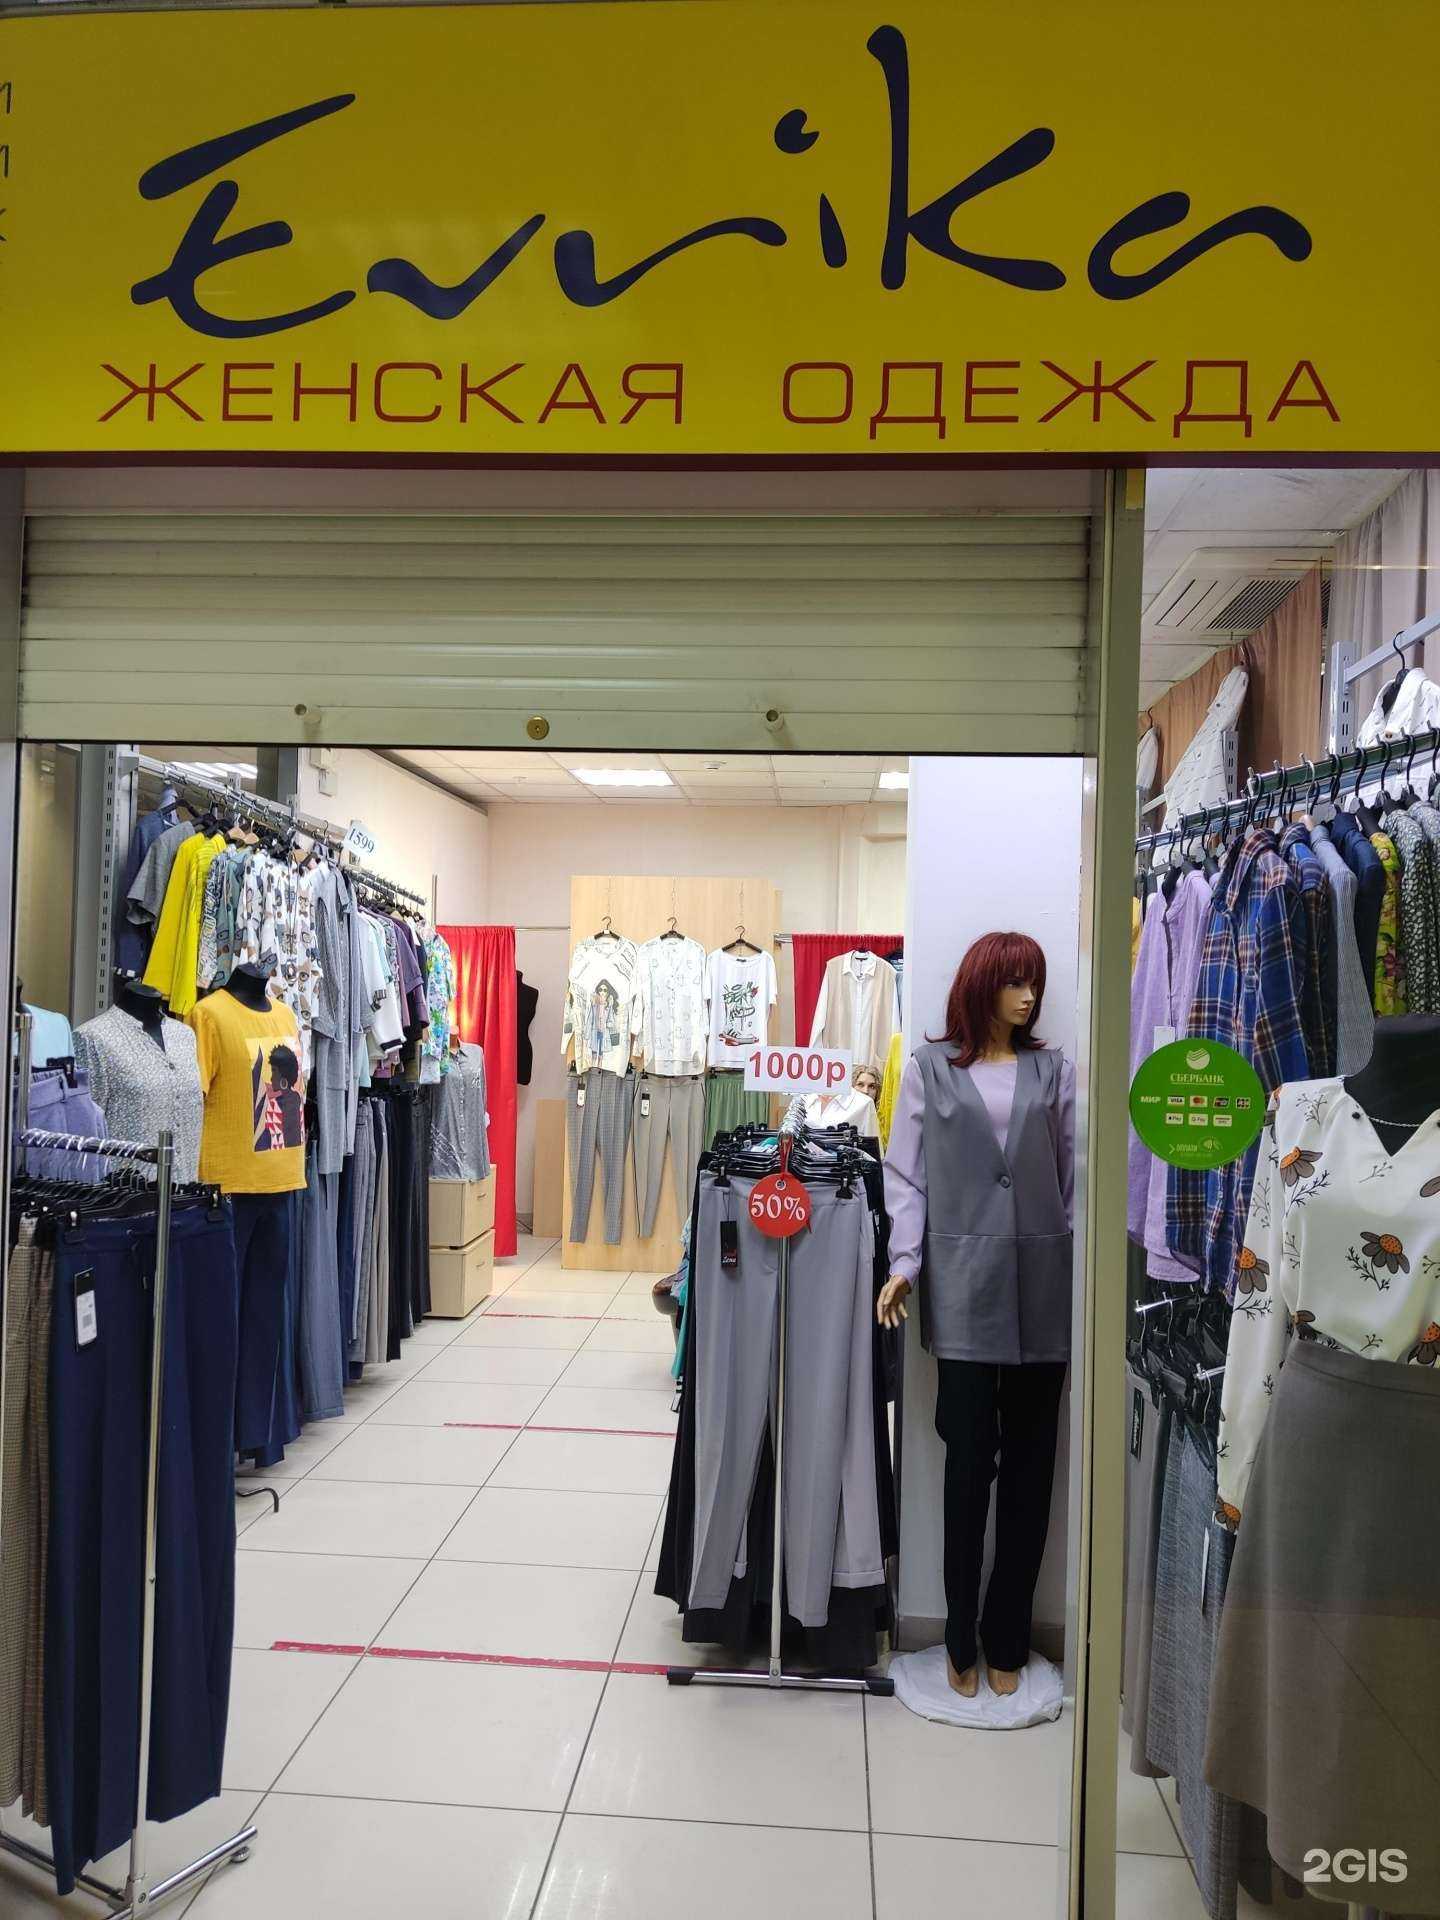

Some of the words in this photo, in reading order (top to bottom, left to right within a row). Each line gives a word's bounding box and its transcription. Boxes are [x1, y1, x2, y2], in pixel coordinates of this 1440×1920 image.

[98, 363, 684, 424] ЖЕНСКАЯ
[782, 360, 1341, 440] ОДЕЖДА
[349, 828, 375, 853] 1599
[1170, 1073, 1225, 1084] СБЕРБАНК
[750, 1193, 806, 1221] 50%
